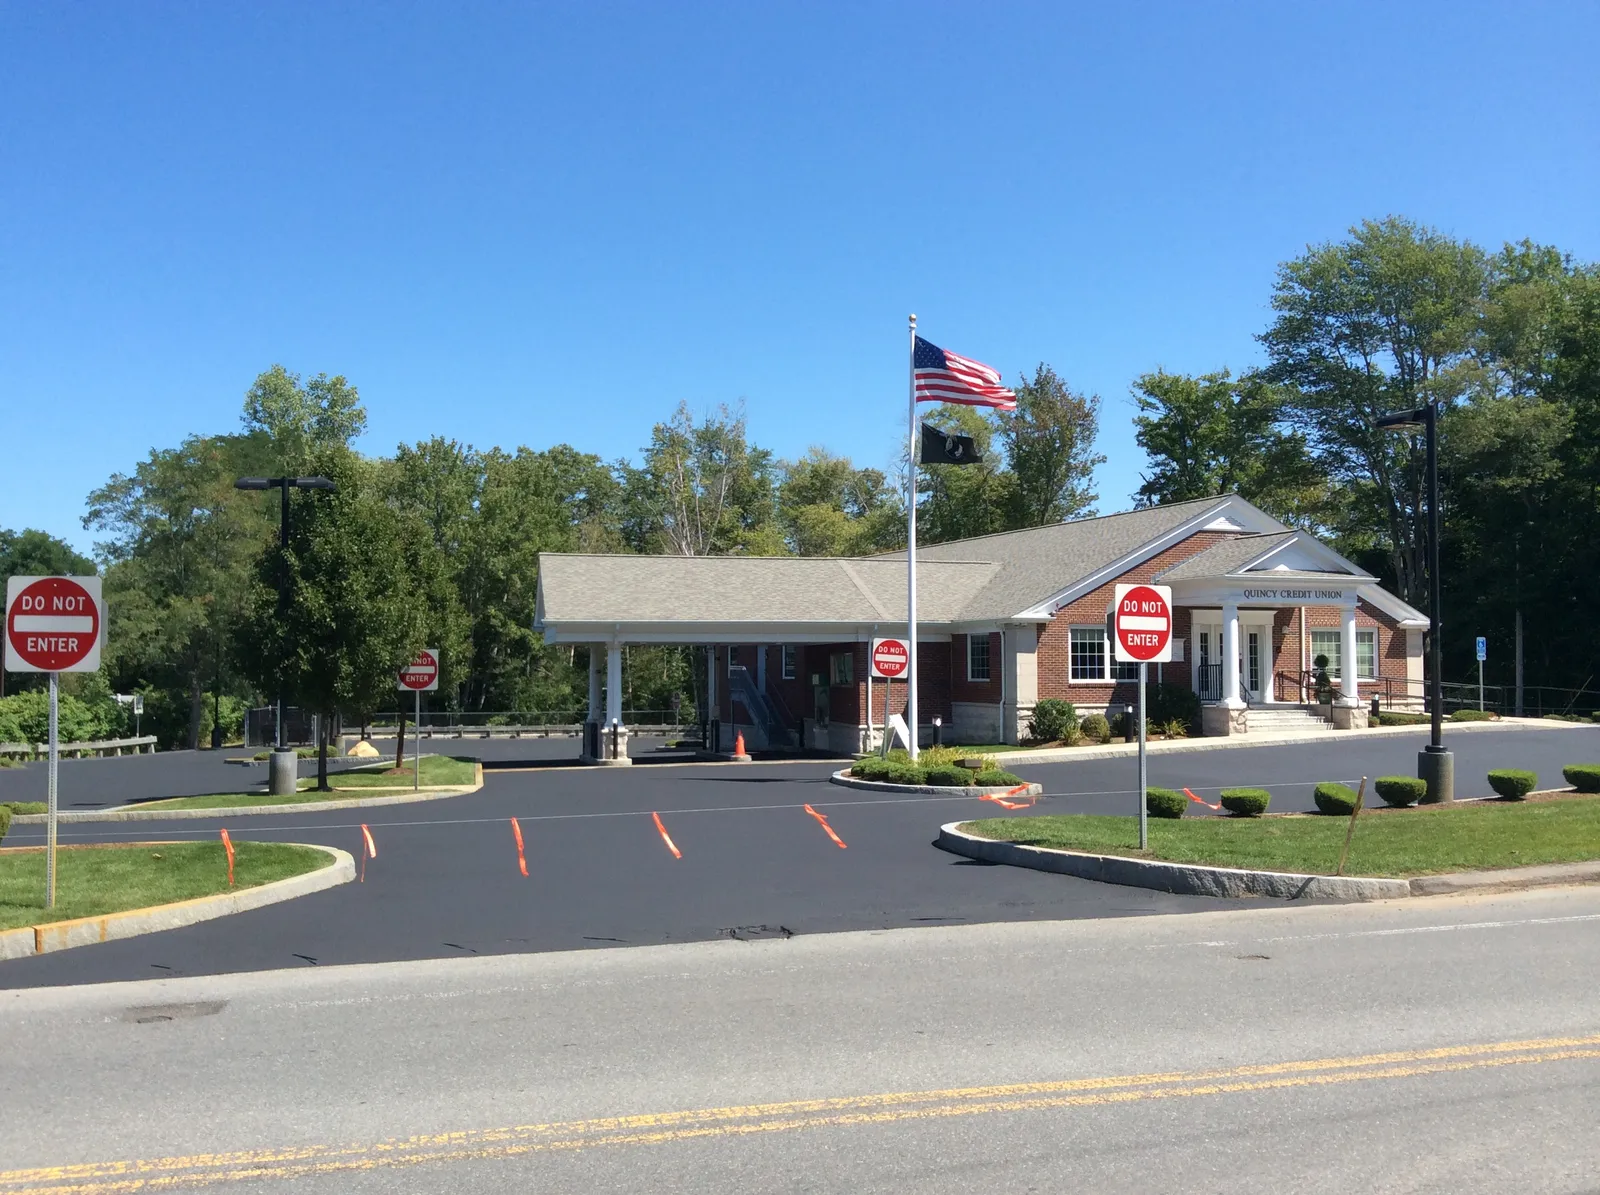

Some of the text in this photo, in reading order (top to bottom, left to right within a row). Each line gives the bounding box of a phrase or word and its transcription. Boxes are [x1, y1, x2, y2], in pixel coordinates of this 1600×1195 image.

[1243, 589, 1342, 599] QUINCY CREDIT UNION
[22, 595, 86, 611] DO NOT
[1123, 600, 1163, 614] DO NOT
[27, 637, 79, 652] ENTER
[1127, 633, 1159, 647] ENTER
[878, 645, 889, 653] DO
[879, 662, 900, 671] ENTER
[405, 674, 429, 682] ENTER
